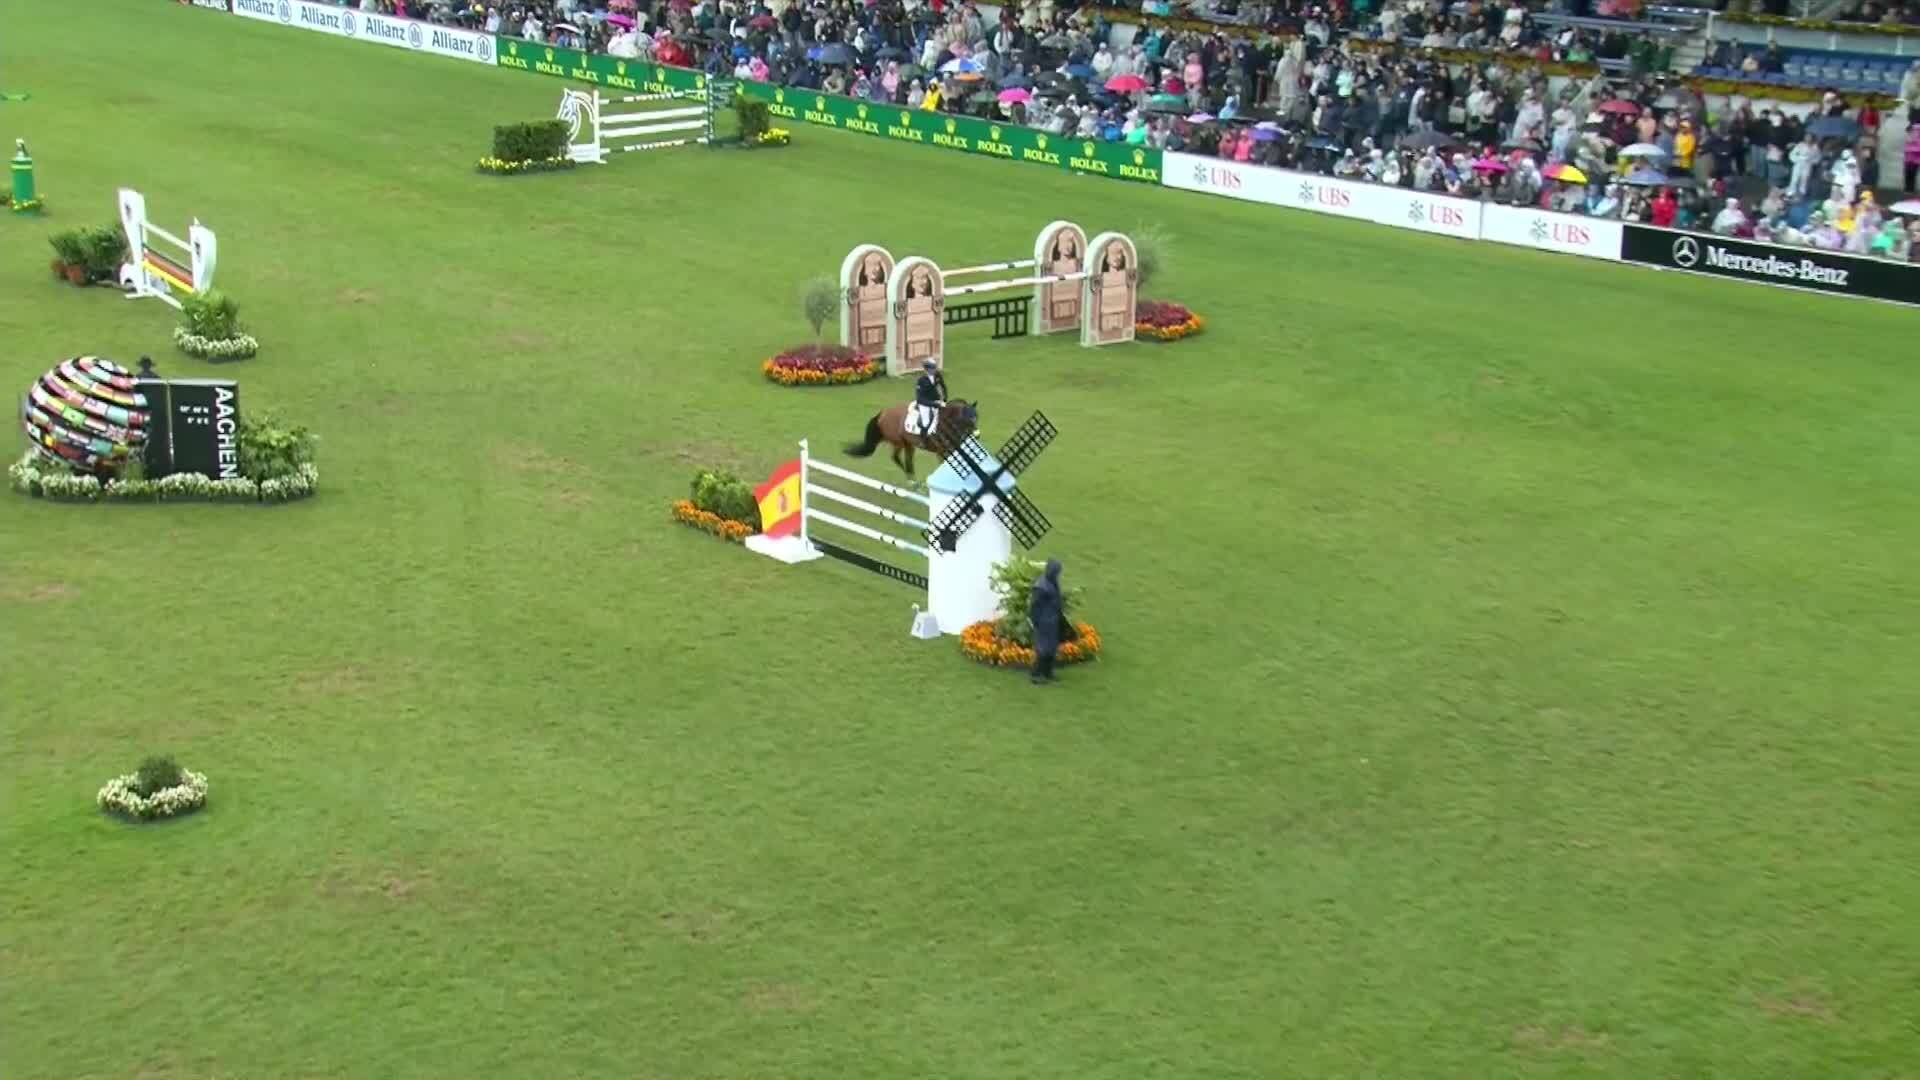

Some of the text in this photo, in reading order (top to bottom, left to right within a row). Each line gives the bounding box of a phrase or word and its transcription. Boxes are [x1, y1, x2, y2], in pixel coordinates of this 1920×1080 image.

[300, 6, 340, 29] Allianz
[365, 18, 406, 41] Allianz
[432, 29, 474, 54] Allianz
[500, 55, 527, 69] ROLEX
[536, 61, 564, 76] ROLEX
[572, 67, 599, 82] ROLEX
[607, 74, 636, 89] ROLEX
[767, 103, 796, 118] OLEX
[805, 110, 837, 125] ROLEX
[846, 117, 879, 135] ROLEX
[888, 125, 923, 141] ROLEX
[933, 133, 968, 148] ROLEX
[977, 140, 1013, 156] ROLEX
[1024, 148, 1060, 164] ROLEX
[1070, 156, 1108, 172] ROLEX
[1120, 164, 1158, 181] ROLEX
[1211, 170, 1241, 189] UBS
[1318, 186, 1350, 207] UBS
[1429, 204, 1464, 226] UBS
[1553, 223, 1590, 244] UBS
[1706, 245, 1849, 286] Mercedes-Benz
[215, 387, 238, 478] AACHEN
